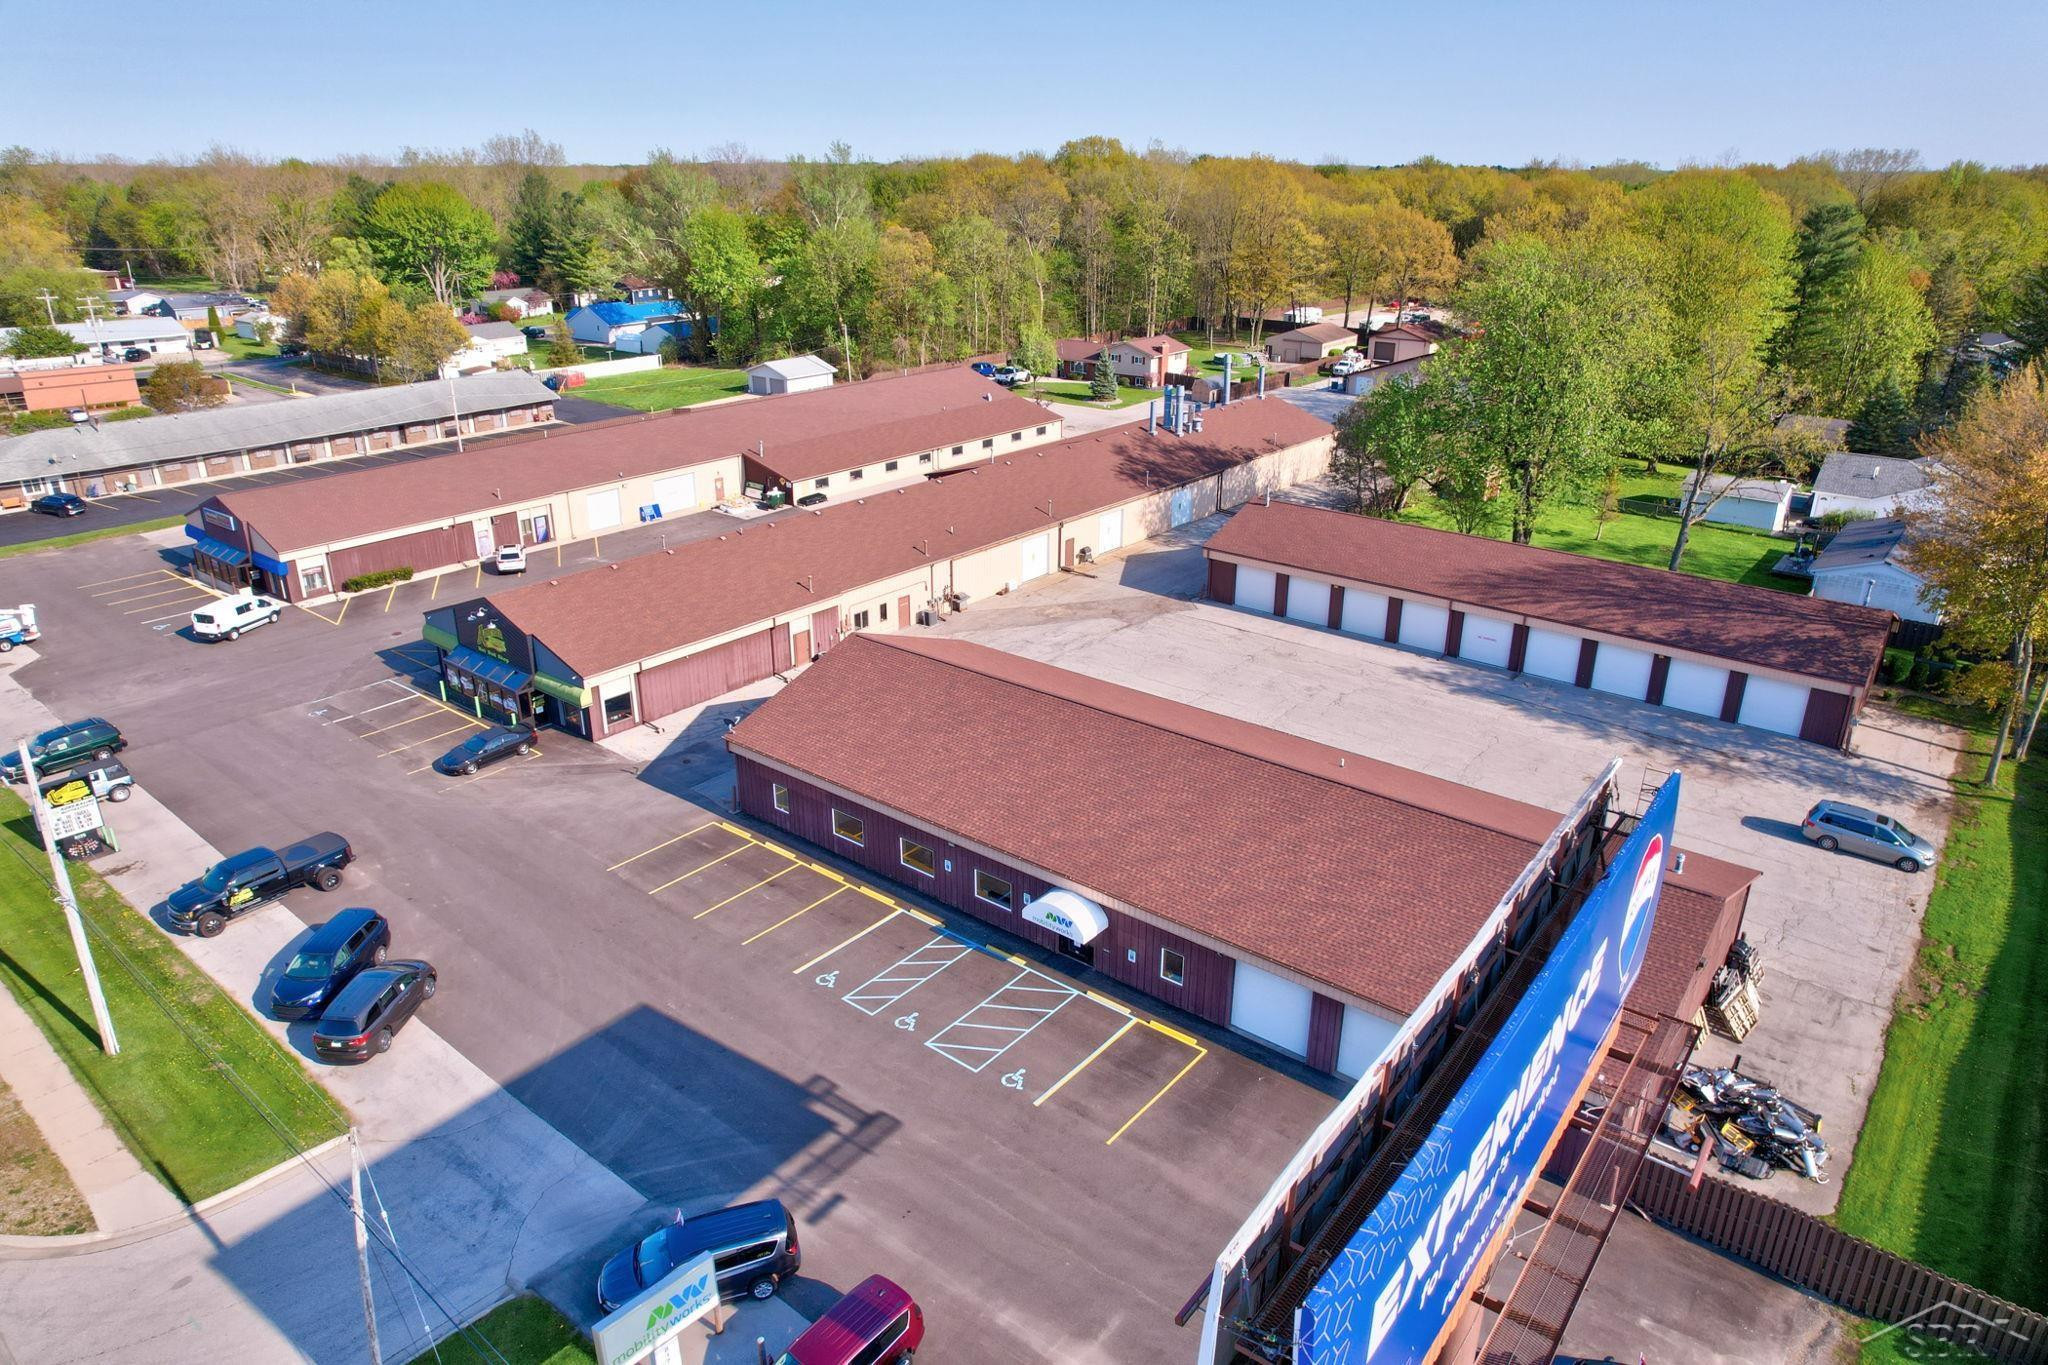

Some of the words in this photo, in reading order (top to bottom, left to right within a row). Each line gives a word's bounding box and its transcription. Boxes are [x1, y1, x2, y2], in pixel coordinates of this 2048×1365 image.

[1366, 936, 1608, 1364] EXPERIENCE
[1420, 1253, 1449, 1310] for
[1452, 1150, 1511, 1255] today's
[612, 1294, 711, 1365] mobilityworks
